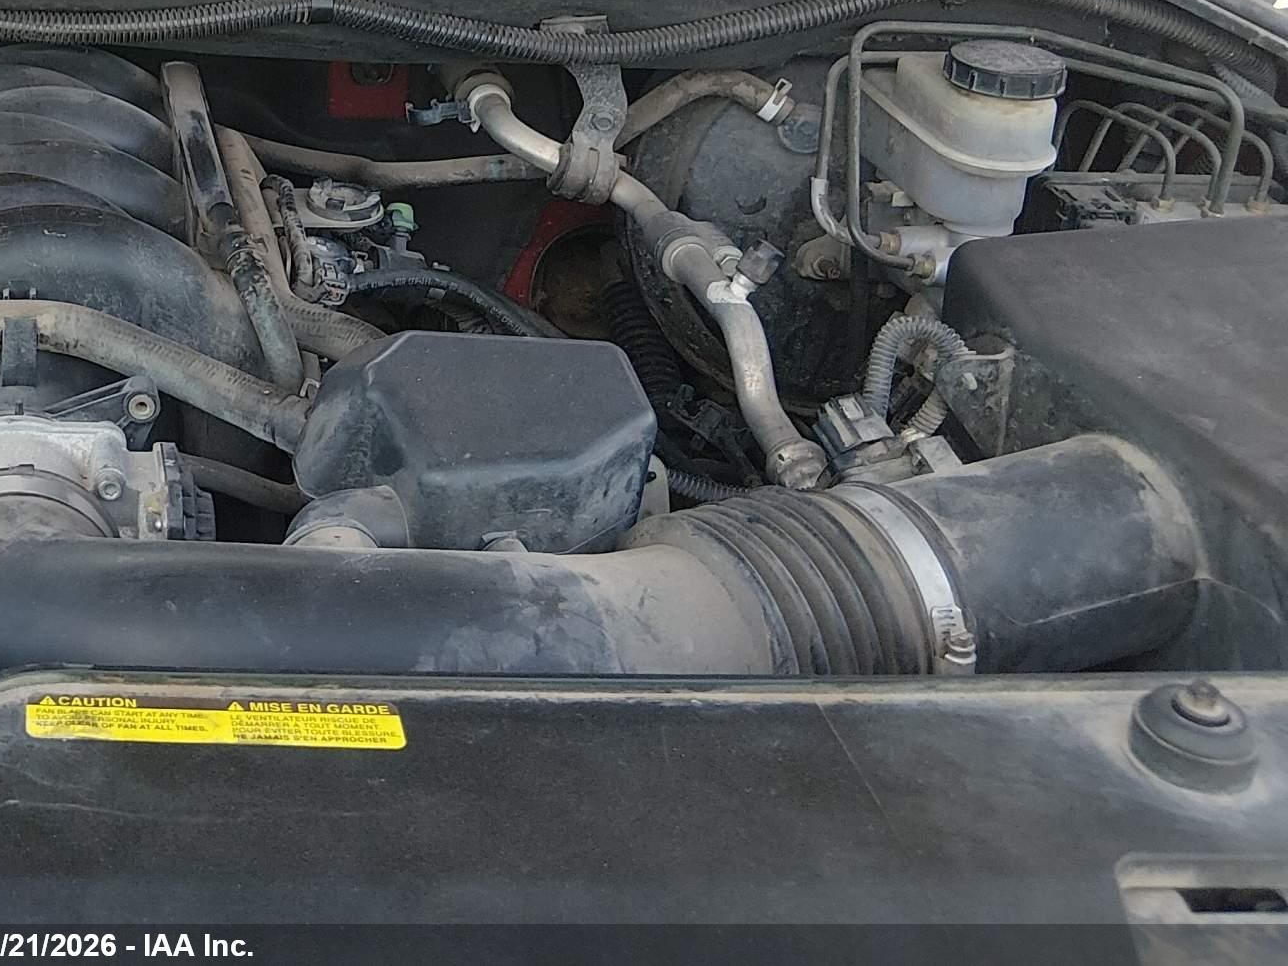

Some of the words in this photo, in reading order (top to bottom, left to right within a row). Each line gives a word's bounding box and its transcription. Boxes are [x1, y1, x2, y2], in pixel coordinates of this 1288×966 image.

[58, 696, 137, 708] CAUTION
[249, 701, 293, 712] MISE
[297, 703, 322, 713] EN
[326, 704, 390, 715] GARDE
[85, 715, 138, 723] PERSONAL
